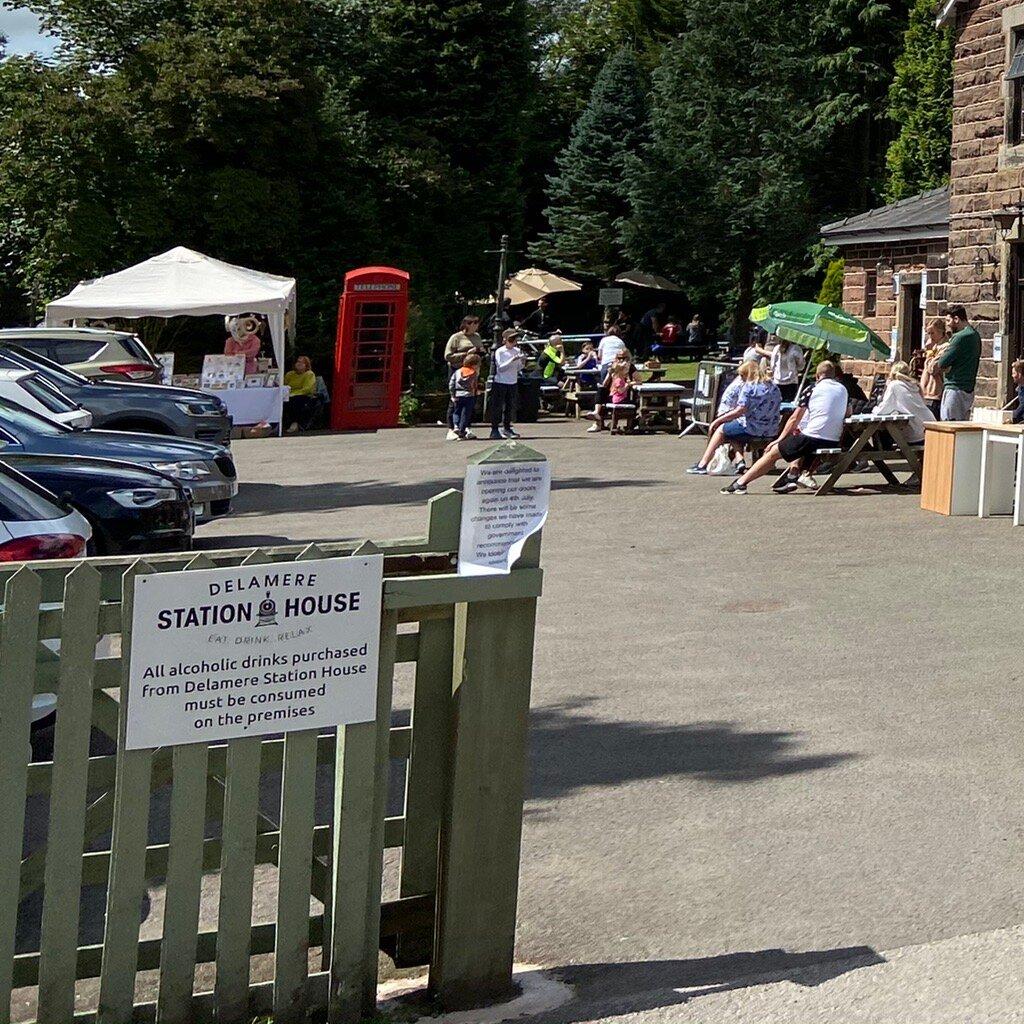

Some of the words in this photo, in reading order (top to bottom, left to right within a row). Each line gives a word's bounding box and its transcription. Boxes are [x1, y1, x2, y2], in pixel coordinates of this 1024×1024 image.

[209, 573, 318, 596] DELAMERE
[157, 601, 252, 630] STATION
[285, 592, 361, 618] HOUSE
[142, 665, 165, 680] All
[169, 658, 238, 677] alcoholic
[242, 650, 288, 669] drinks
[292, 643, 368, 666] purchased
[142, 683, 180, 698] from
[184, 674, 259, 694] Delamere
[264, 667, 317, 685] Station
[321, 662, 368, 678] House
[185, 696, 223, 712] must
[227, 692, 246, 707] be
[250, 683, 326, 704] consumed
[194, 717, 213, 729] on
[218, 711, 243, 725] the
[247, 705, 315, 726] premises
